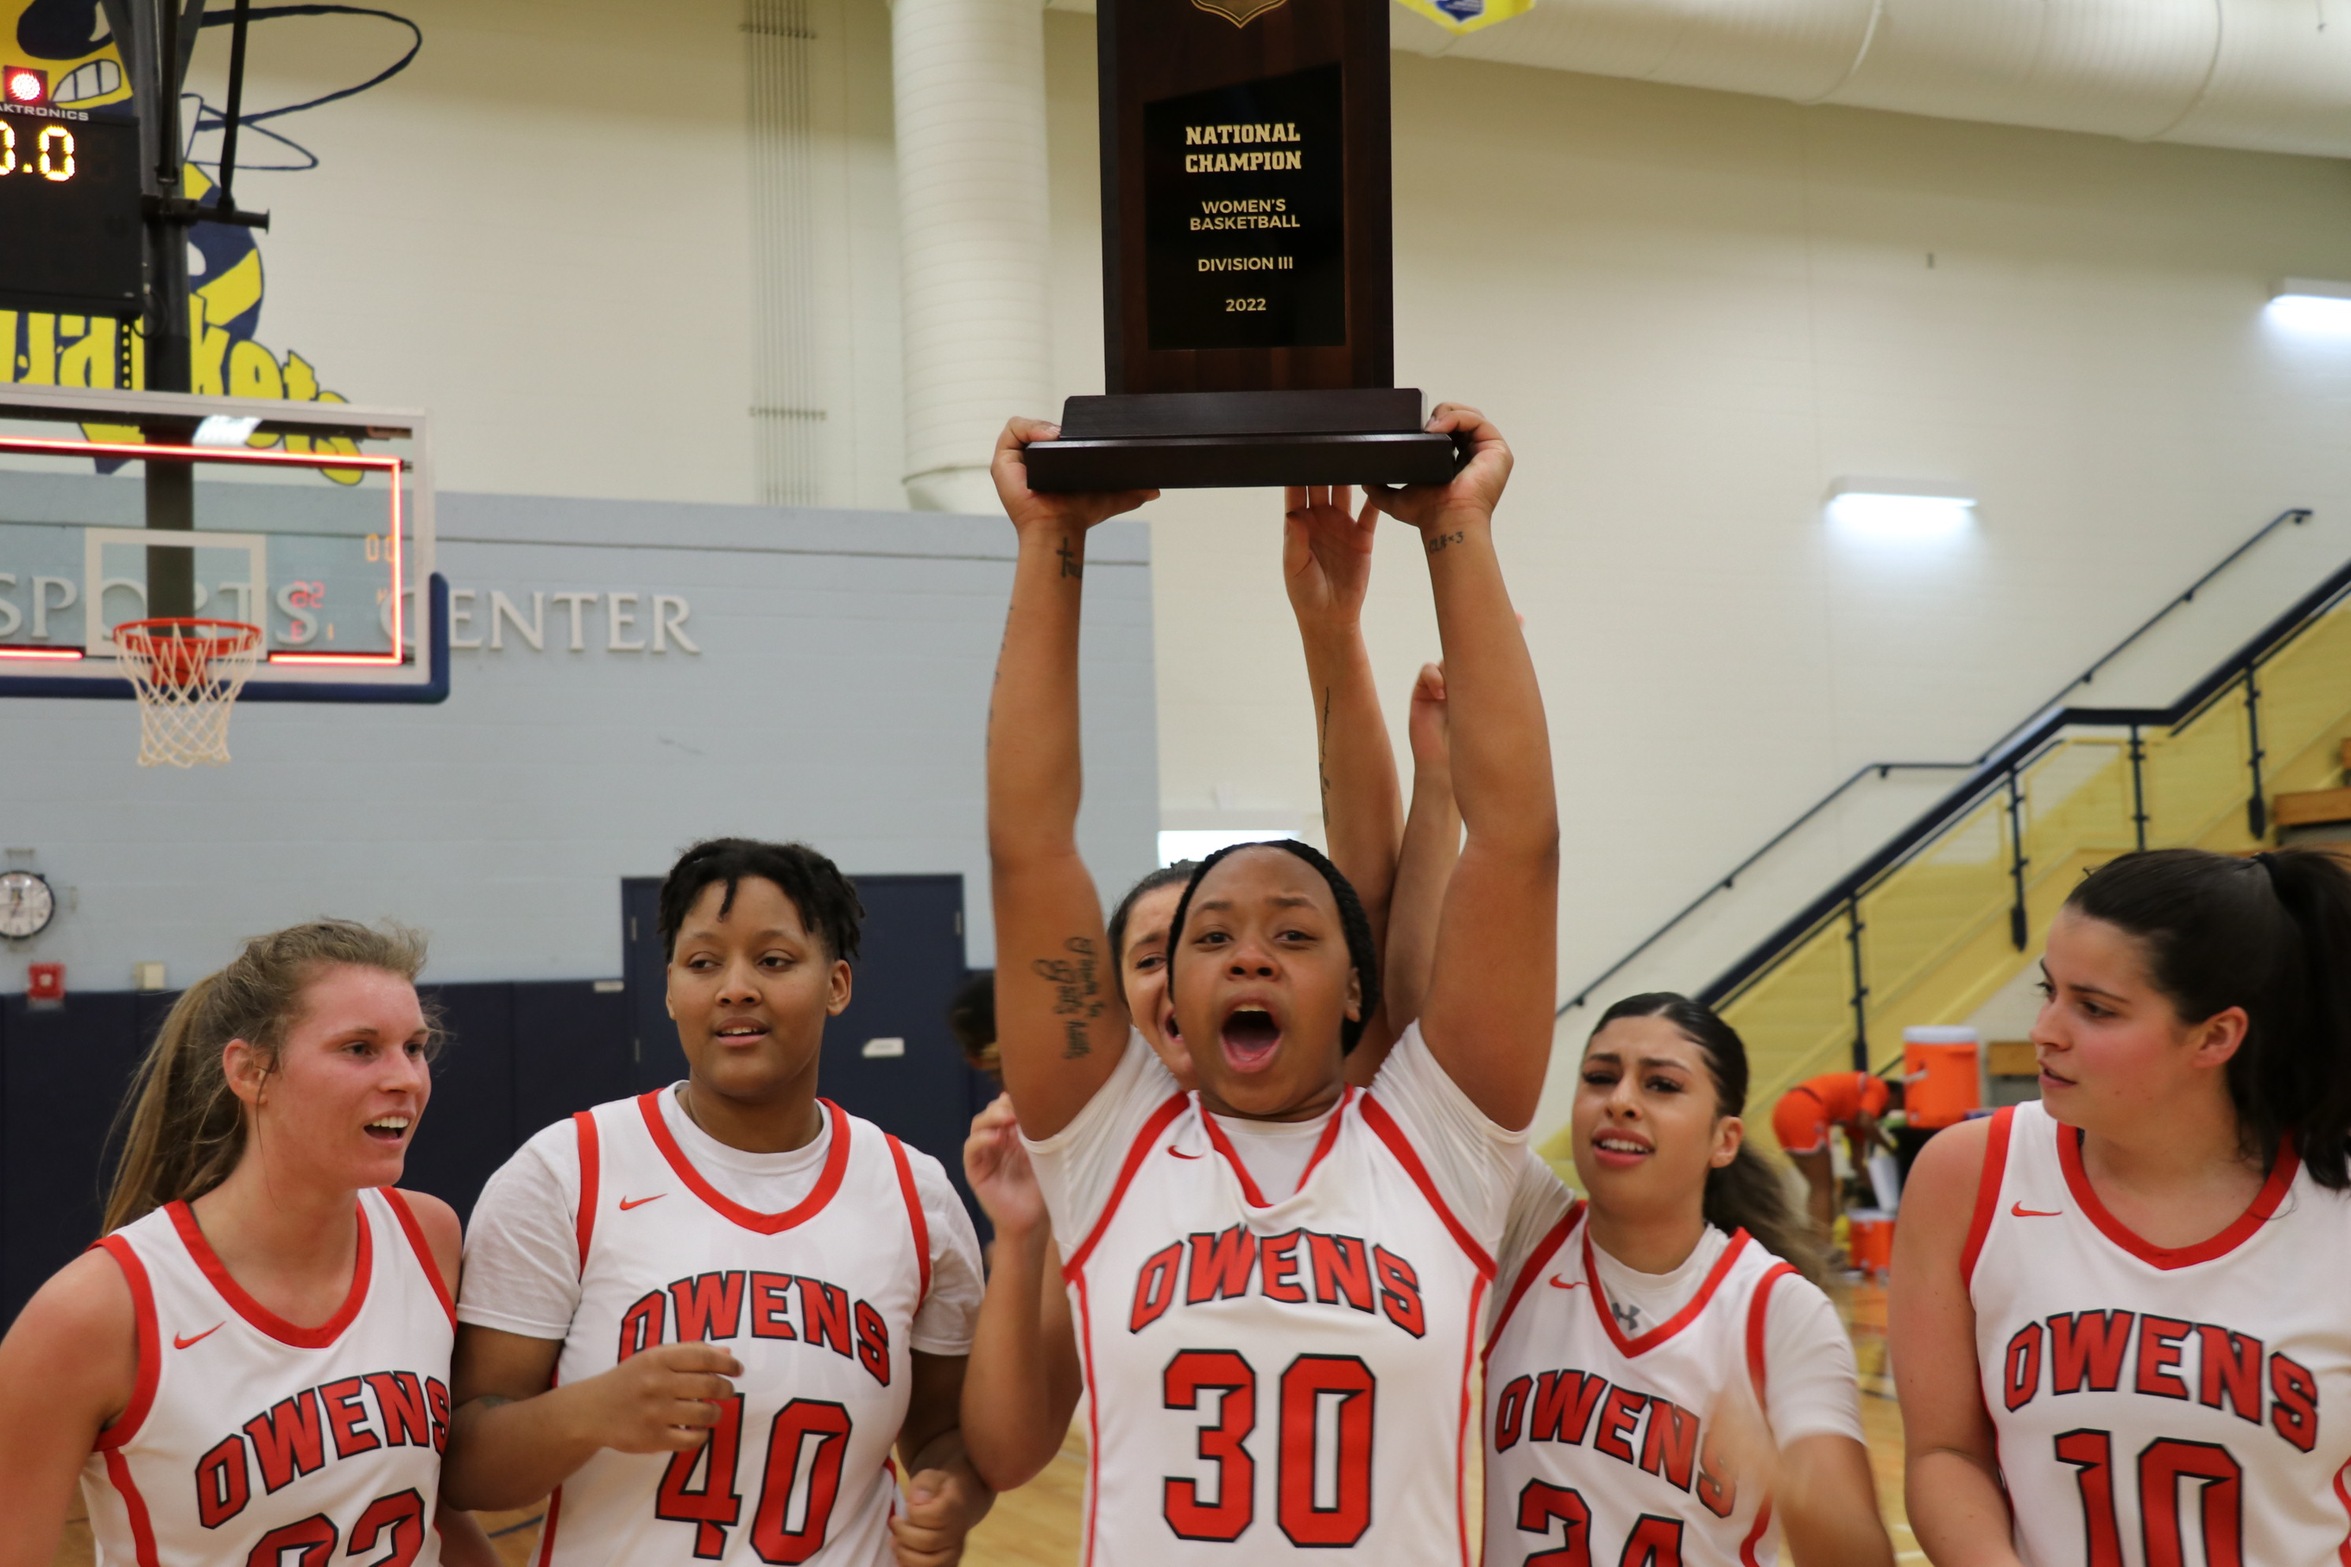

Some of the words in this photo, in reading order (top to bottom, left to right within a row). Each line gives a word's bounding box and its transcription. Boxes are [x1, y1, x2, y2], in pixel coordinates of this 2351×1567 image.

[1185, 123, 1300, 145] NATIONAL
[1185, 151, 1301, 173] CHAMPION
[1190, 215, 1300, 230] BASKETBALL
[1198, 257, 1273, 272] DIVISION
[1278, 256, 1293, 269] III
[1202, 199, 1286, 214] WOMEN'S
[1225, 298, 1266, 312] 2022
[618, 1270, 890, 1387] OWENS
[1130, 1222, 1425, 1339] OWENS
[2004, 1308, 2318, 1453] OWENS
[195, 1371, 452, 1530] OWENS
[655, 1392, 852, 1566] 40
[1163, 1348, 1376, 1548] 30
[1495, 1369, 1738, 1518] OWENS
[2054, 1428, 2243, 1567] 10
